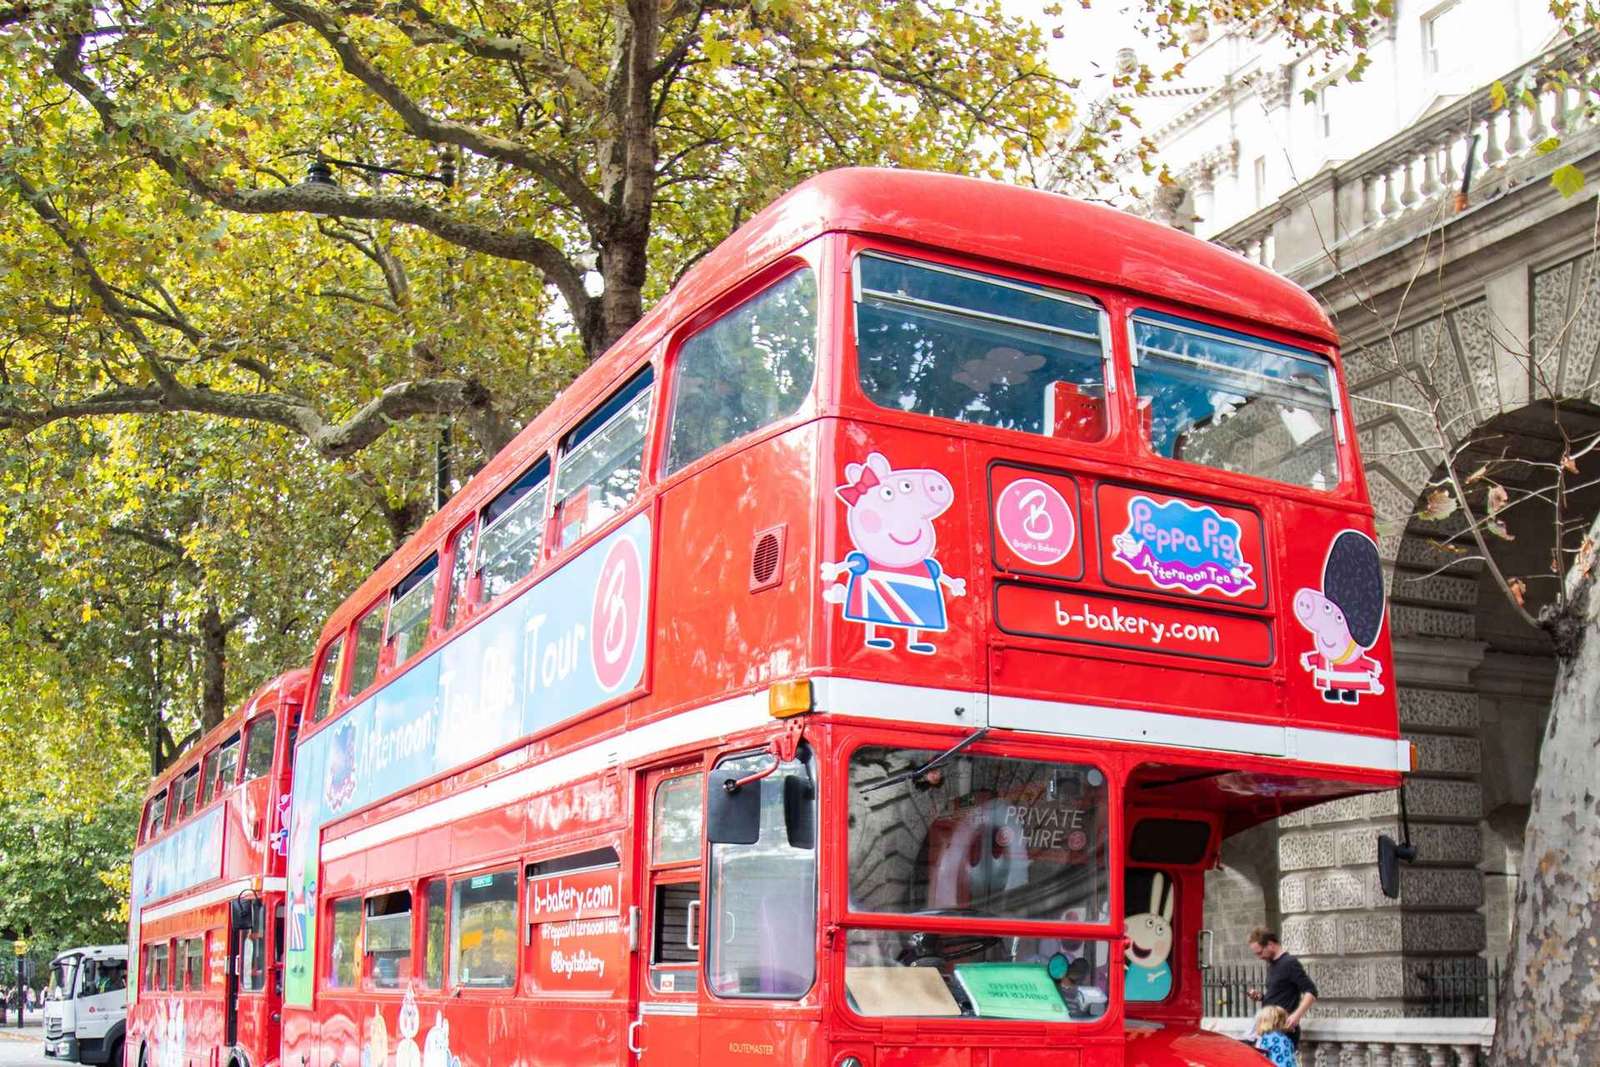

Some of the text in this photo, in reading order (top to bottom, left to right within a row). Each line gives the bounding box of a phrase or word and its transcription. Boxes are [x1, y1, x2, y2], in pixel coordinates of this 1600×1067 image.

[1133, 502, 1236, 562] Peppa Pig
[1142, 553, 1232, 584] Afternoon Tea
[1054, 599, 1220, 644] b-bakery.com
[359, 710, 433, 780] Afternoon
[526, 613, 586, 694] Tour
[1004, 805, 1085, 829] PRIVATE
[1019, 829, 1064, 849] HIRE
[534, 879, 613, 920] b-bakery.com
[728, 1041, 774, 1056] ROUTEMASTER
